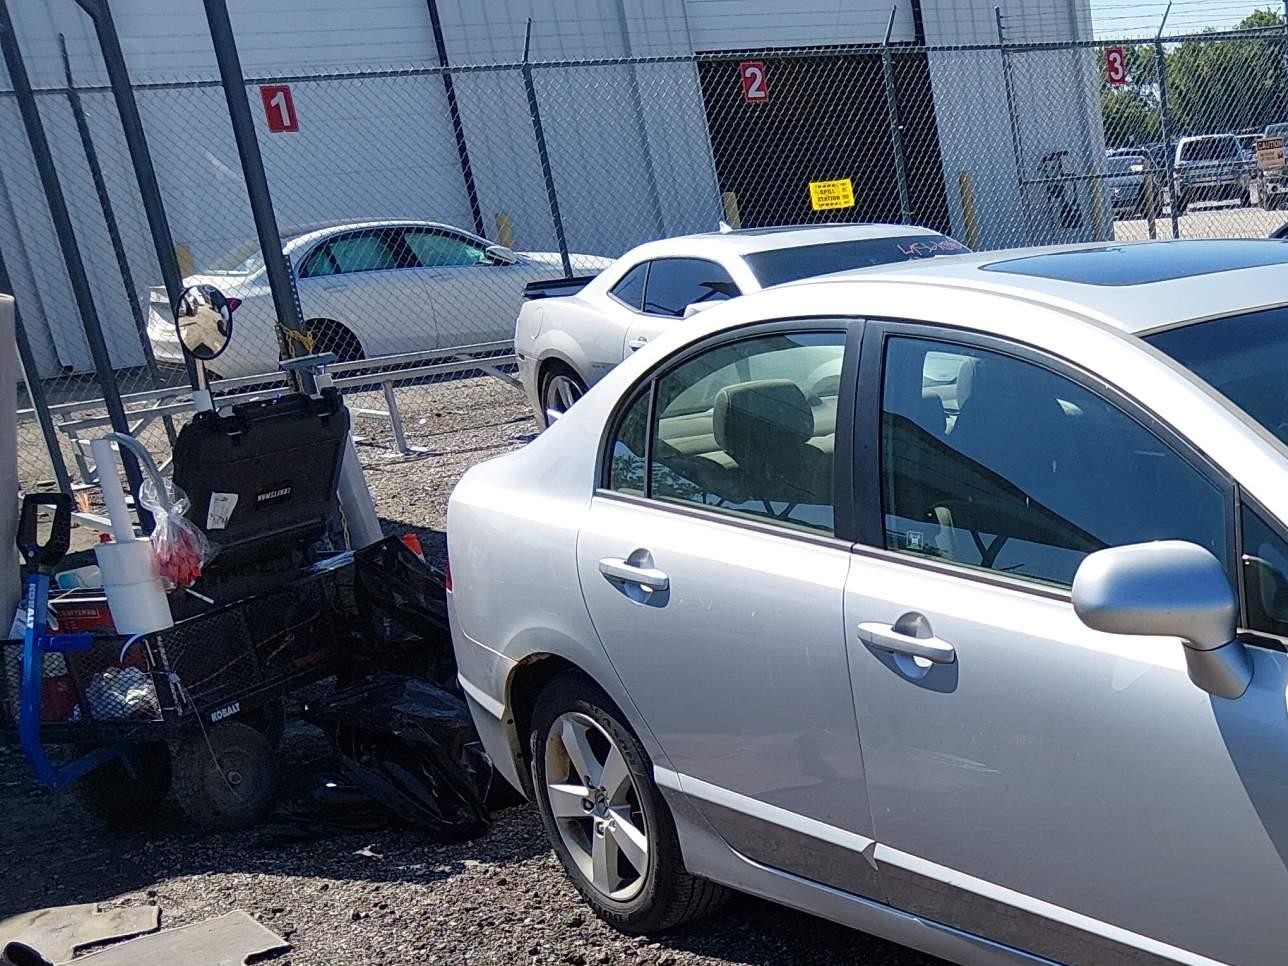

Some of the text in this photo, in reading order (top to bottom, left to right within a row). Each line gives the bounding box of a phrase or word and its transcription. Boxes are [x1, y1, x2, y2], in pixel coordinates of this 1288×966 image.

[1109, 52, 1123, 80] 3
[745, 67, 765, 97] 2
[271, 91, 290, 126] 1
[1257, 140, 1283, 150] CAUTION
[27, 583, 36, 629] KOBALT
[211, 702, 240, 722] KOBALT
